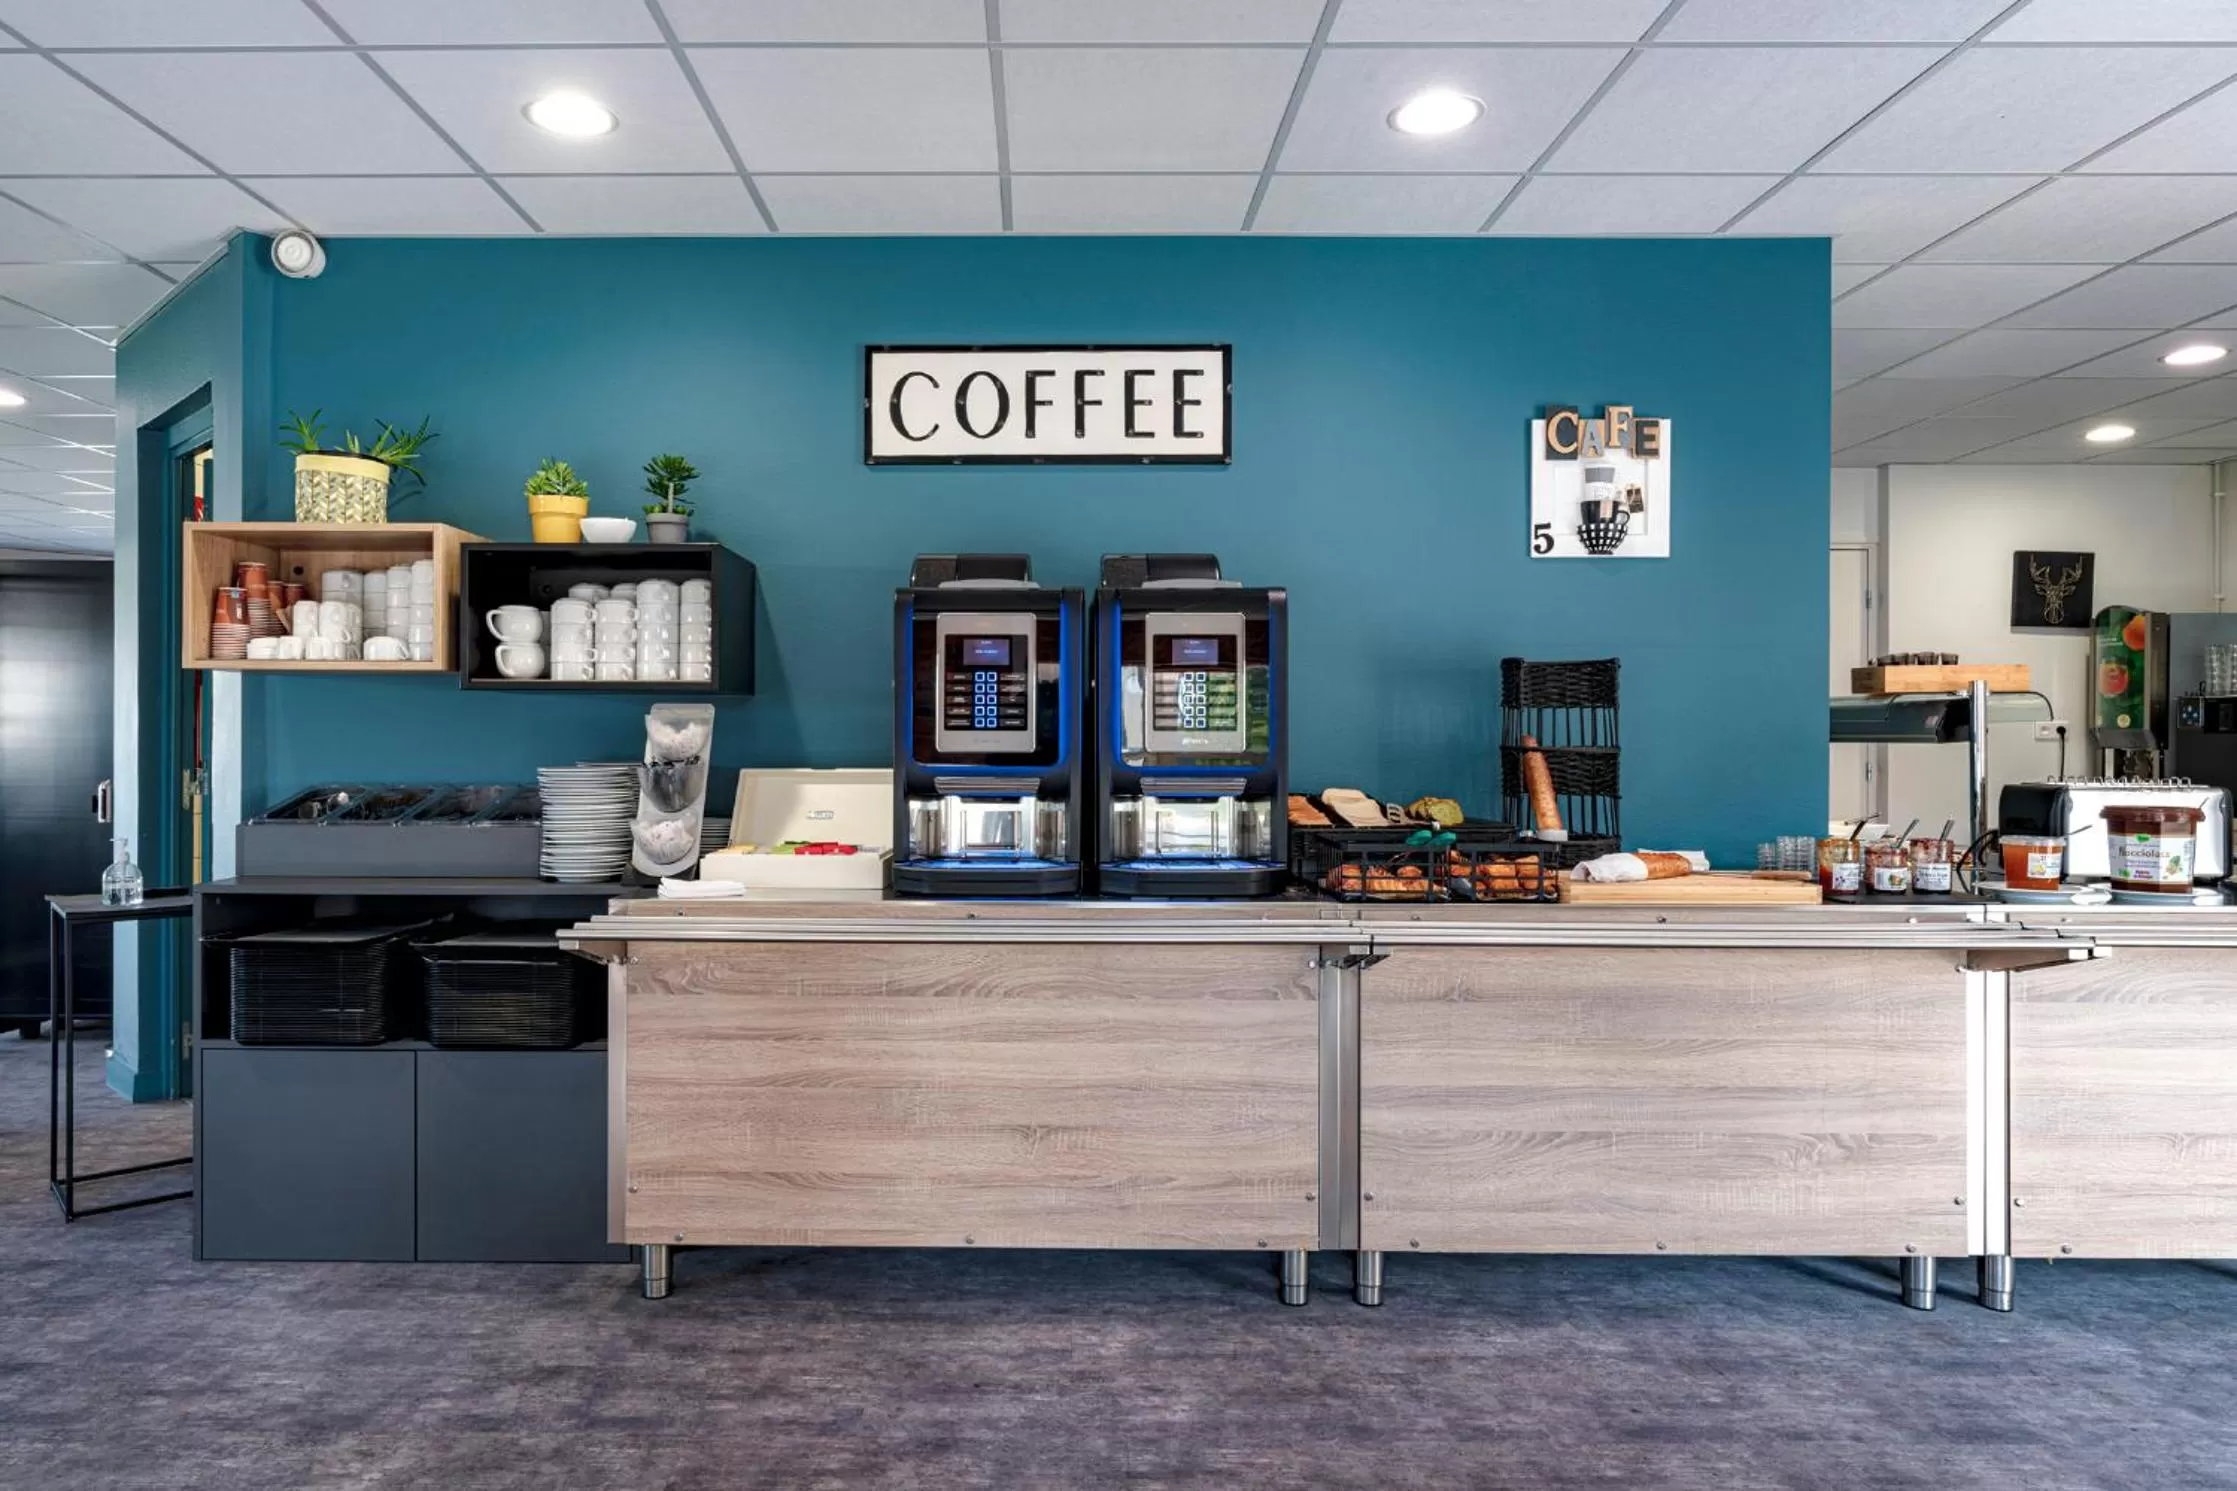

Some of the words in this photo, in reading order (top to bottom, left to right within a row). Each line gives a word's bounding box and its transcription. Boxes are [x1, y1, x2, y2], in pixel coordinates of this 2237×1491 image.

[889, 369, 1204, 442] COFFEE
[1547, 406, 1660, 457] CAFE
[1533, 523, 1555, 555] 5
